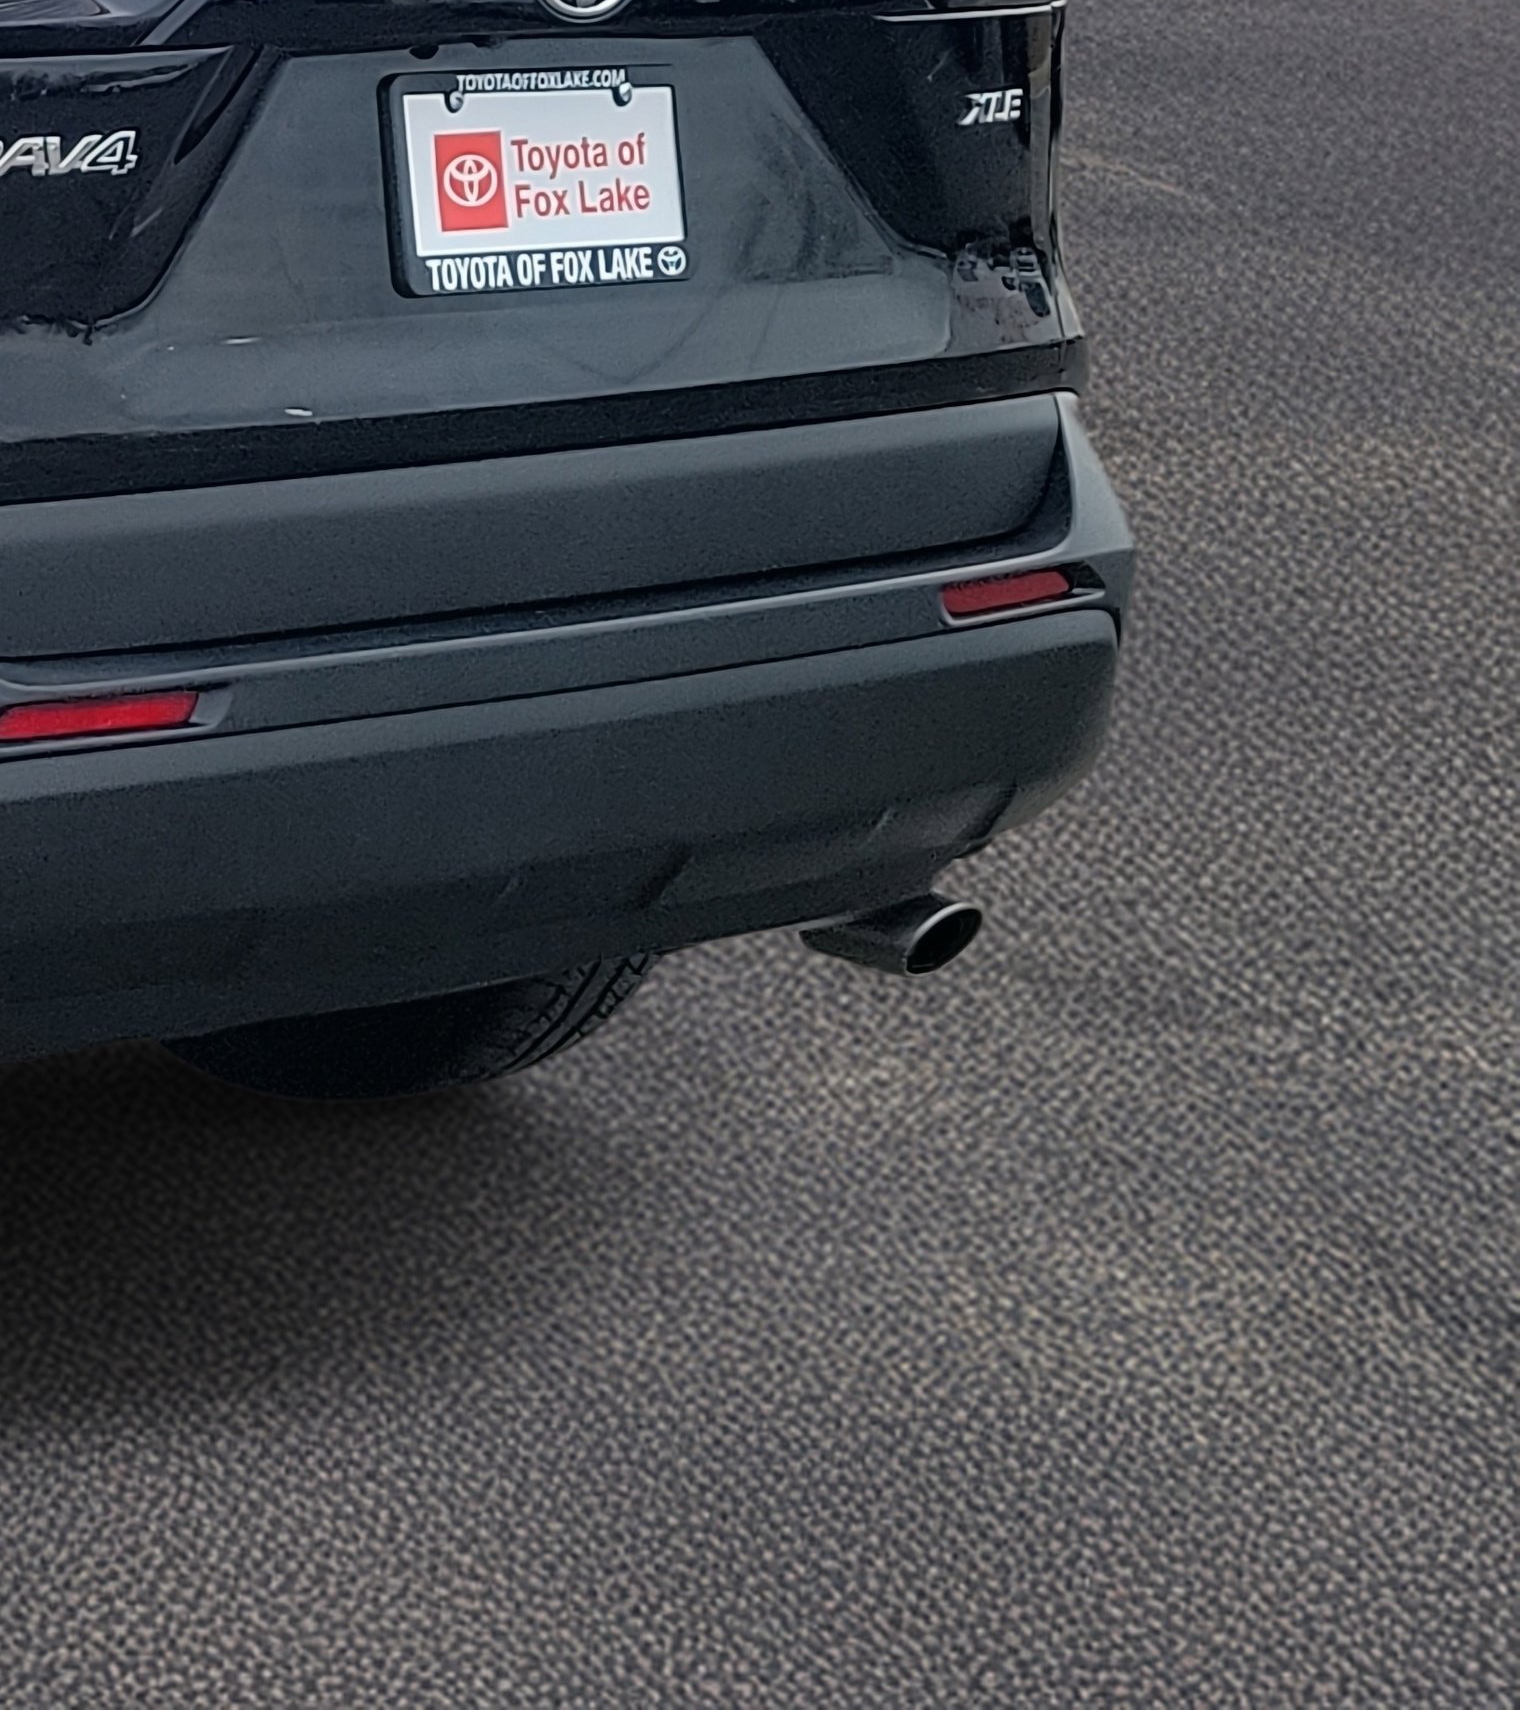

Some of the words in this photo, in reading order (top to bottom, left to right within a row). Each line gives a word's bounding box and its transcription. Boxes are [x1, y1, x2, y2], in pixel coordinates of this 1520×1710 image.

[510, 137, 608, 180] Toyota
[617, 132, 646, 166] of
[514, 183, 571, 219] Fox
[577, 177, 651, 215] Lake
[425, 255, 515, 291] TOYOTA
[516, 252, 547, 286] OF
[549, 249, 594, 284] FOX
[597, 246, 655, 280] LAKE
